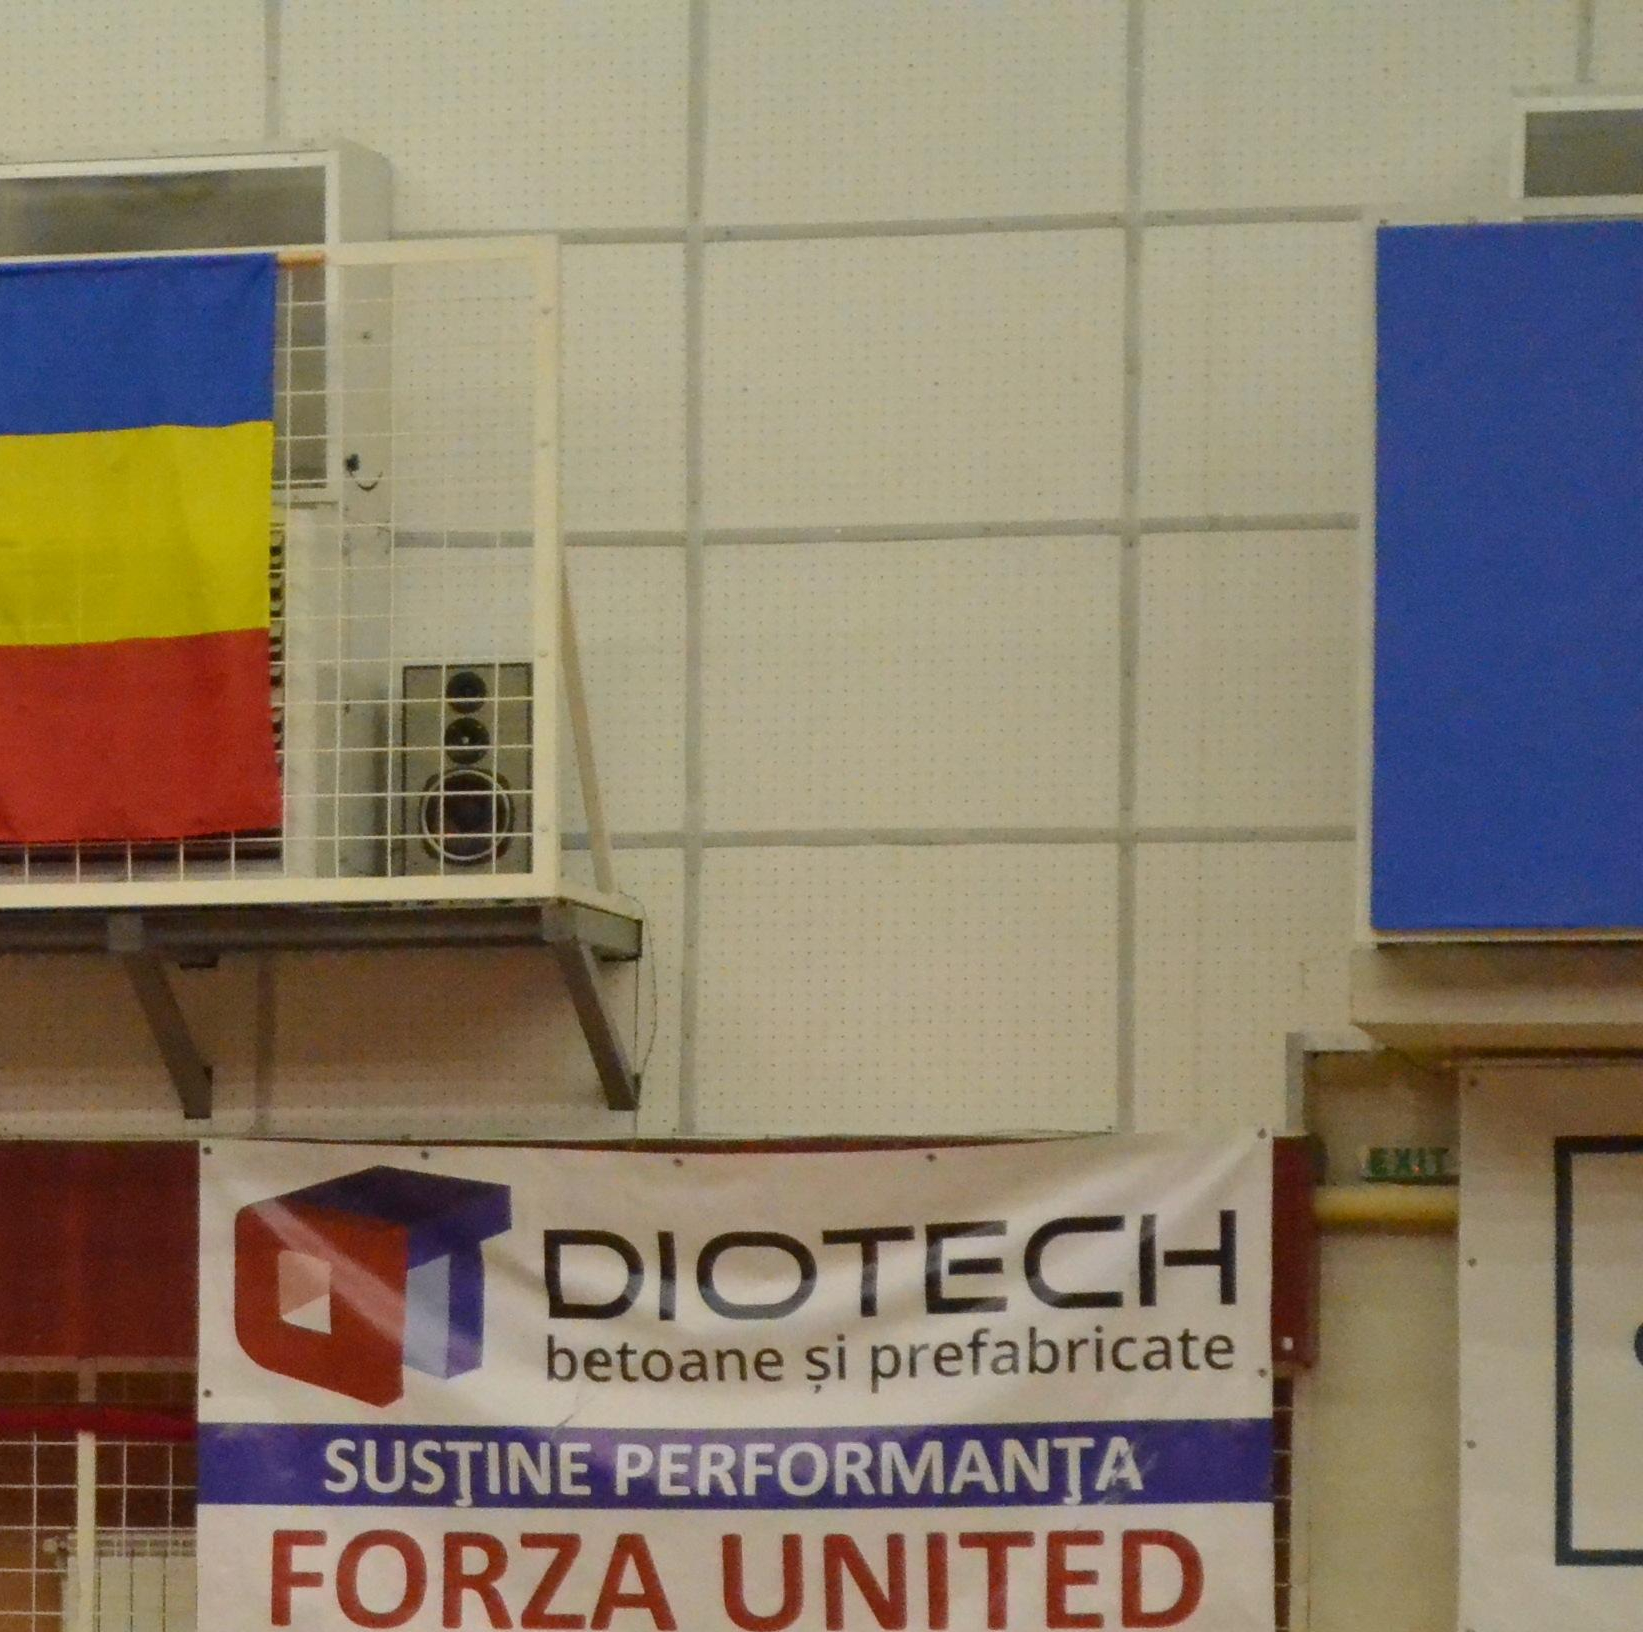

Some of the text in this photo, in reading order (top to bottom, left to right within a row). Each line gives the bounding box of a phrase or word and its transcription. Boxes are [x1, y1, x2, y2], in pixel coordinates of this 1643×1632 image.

[1370, 1147, 1450, 1177] EXIT
[544, 1209, 1237, 1321] DIOTECH
[546, 1325, 1236, 1393] betoane și prefabricate
[270, 1529, 677, 1631] FORZA
